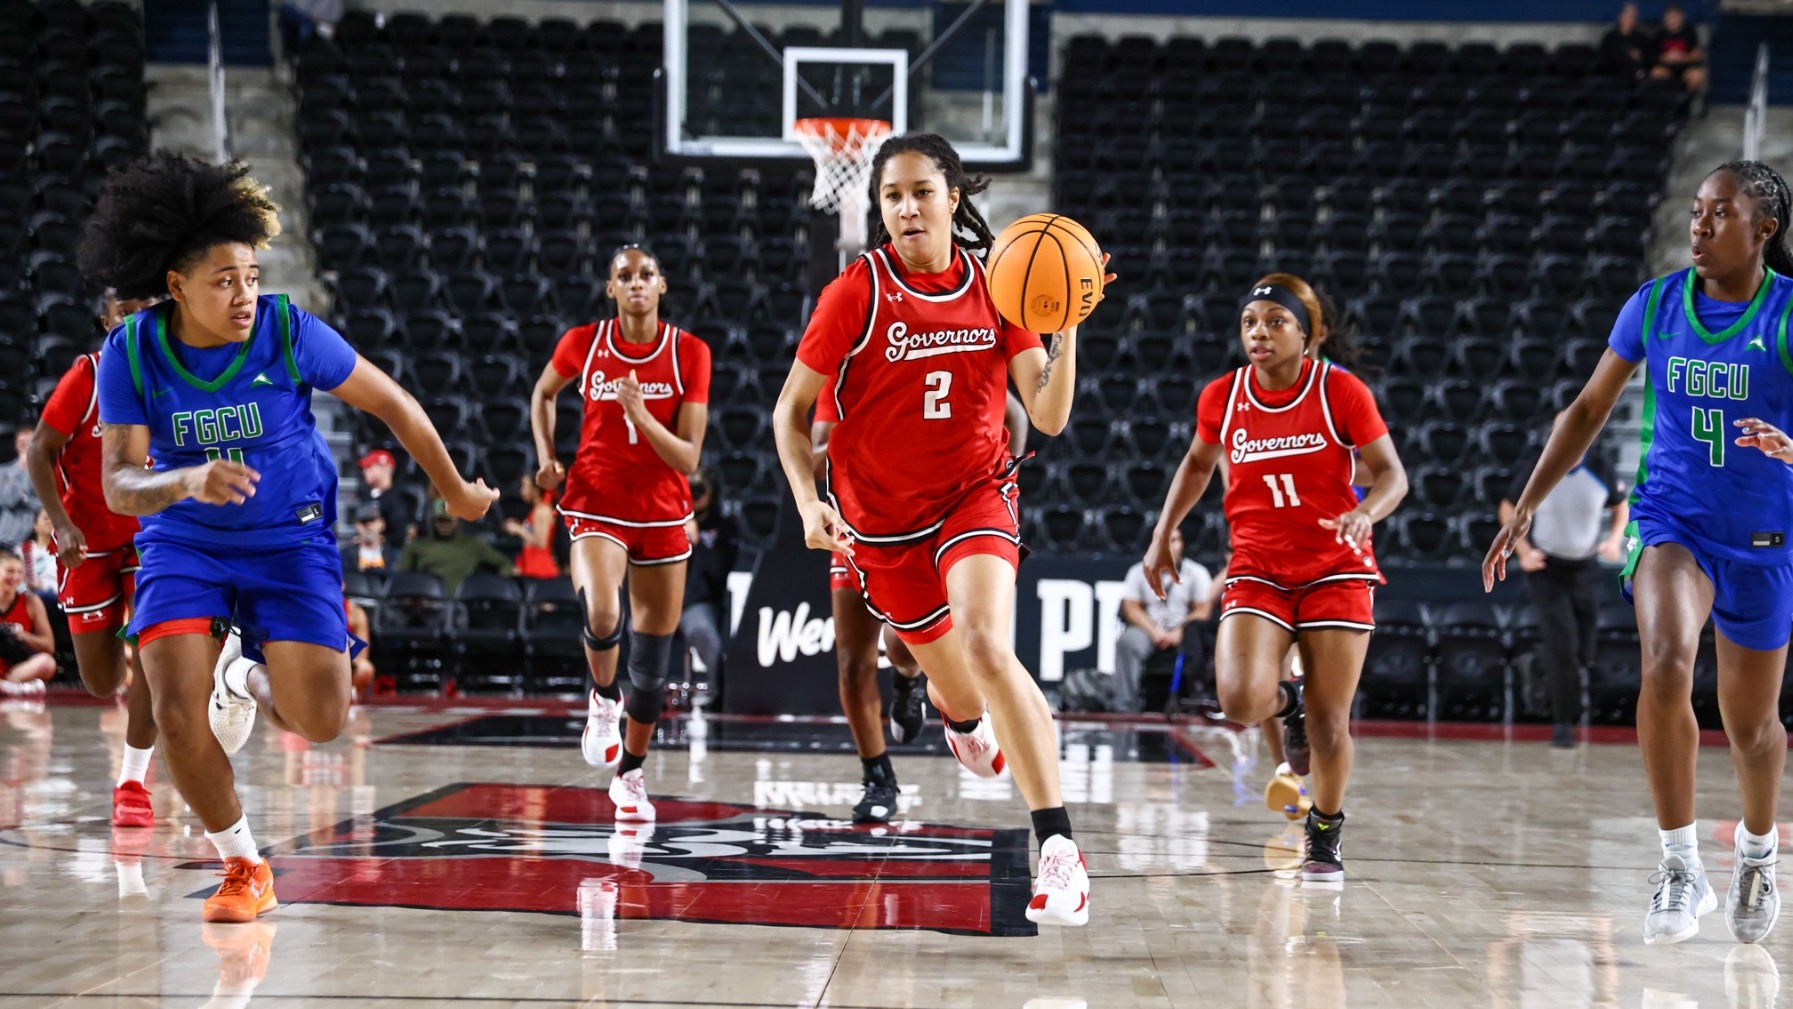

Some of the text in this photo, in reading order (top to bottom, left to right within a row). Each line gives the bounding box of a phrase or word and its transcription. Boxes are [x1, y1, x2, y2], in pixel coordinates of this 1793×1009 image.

[885, 321, 997, 362] Governors
[590, 370, 674, 401] Govnors
[923, 370, 952, 419] 2
[1667, 356, 1749, 400] FGCU
[171, 402, 263, 446] FGCU
[623, 411, 638, 445] 1
[1691, 405, 1724, 467] 4
[1231, 428, 1328, 464] Governors
[1262, 473, 1301, 508] 11
